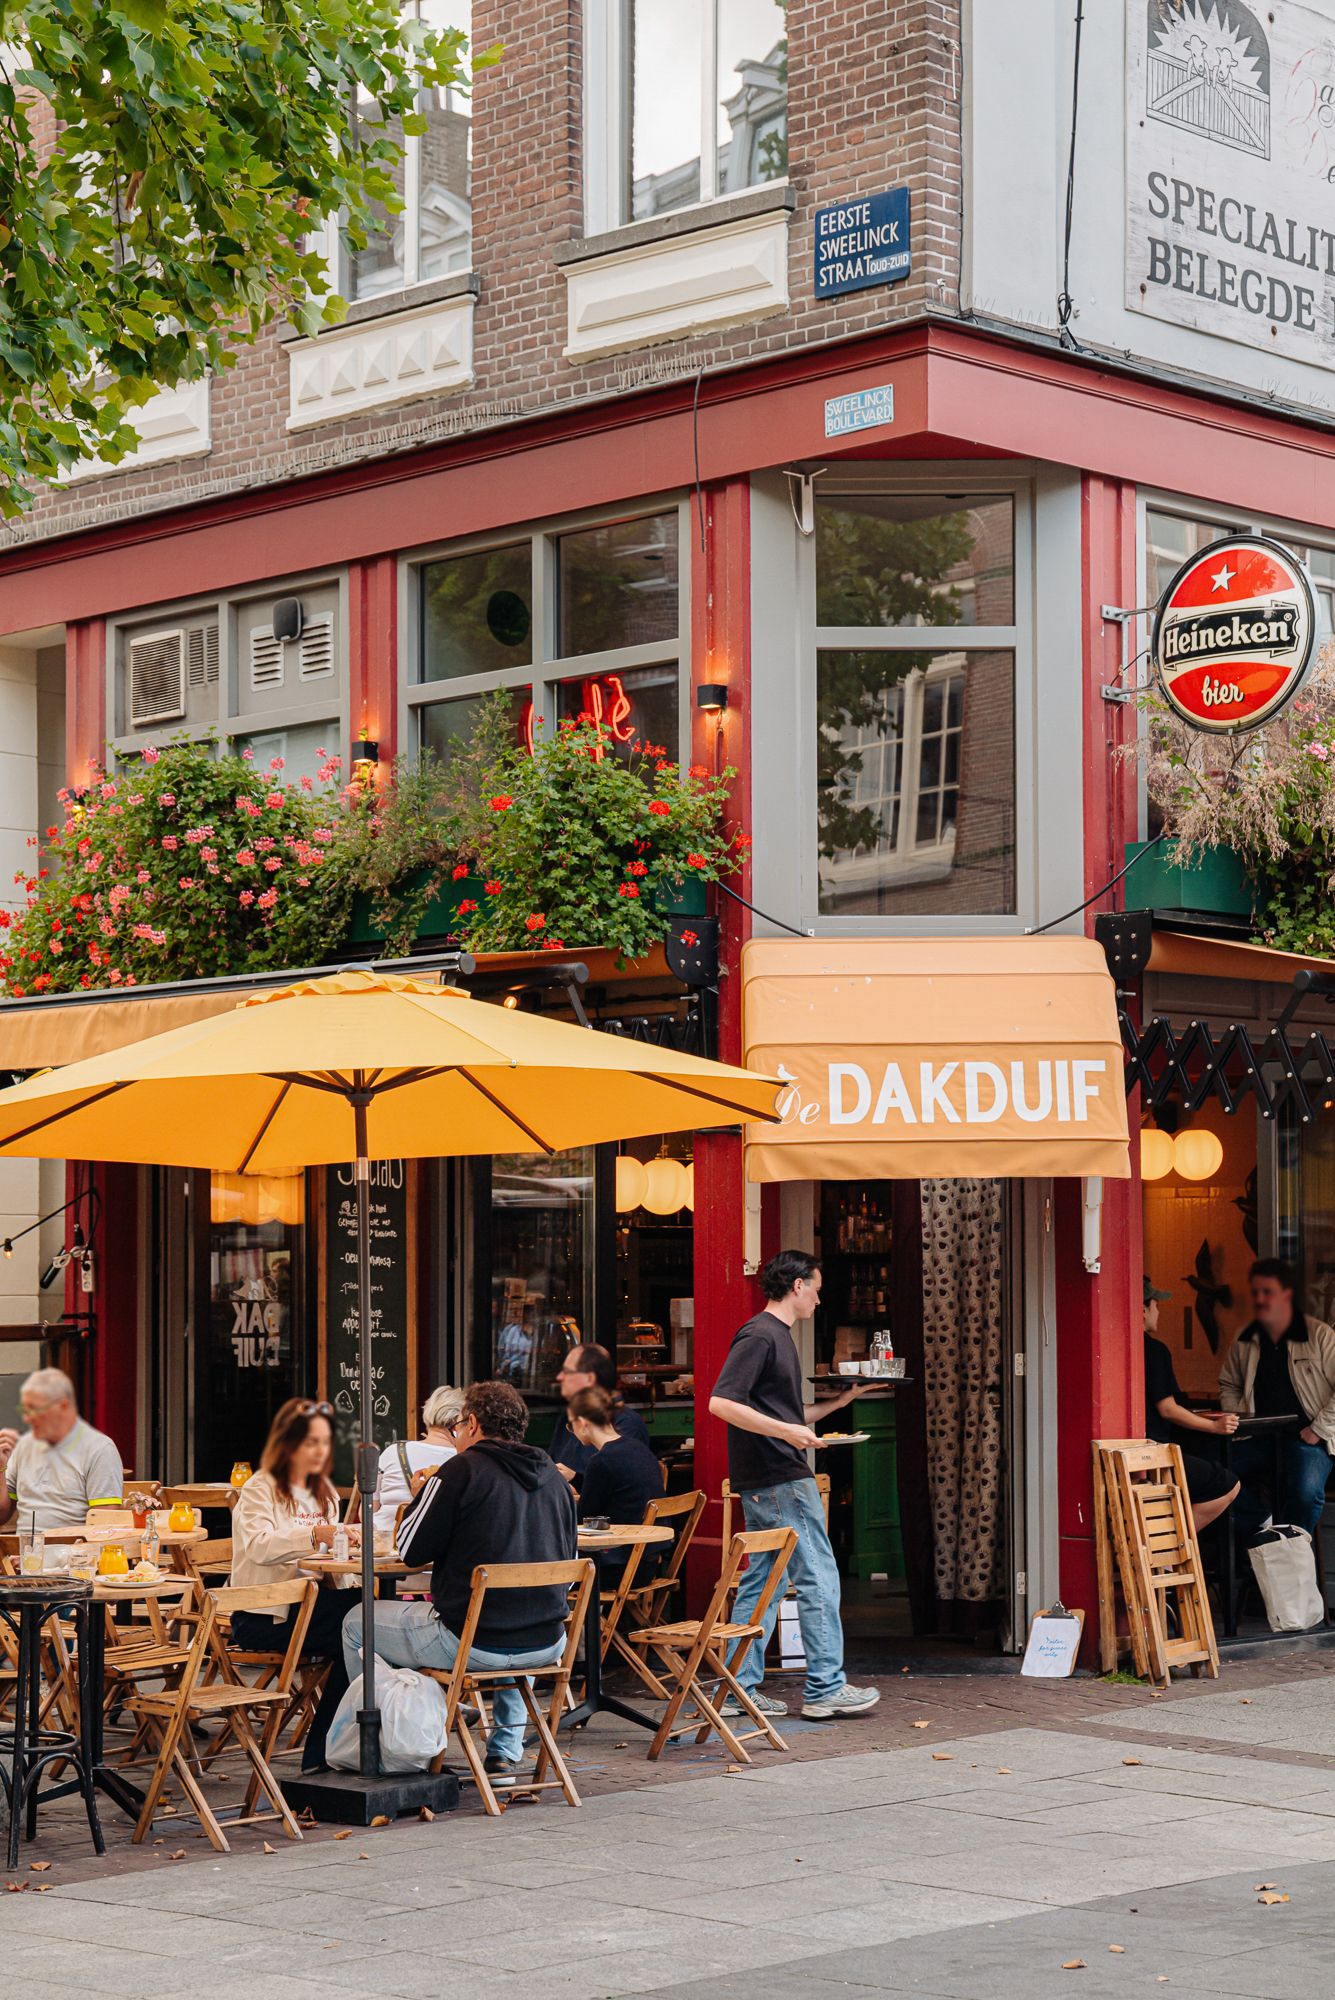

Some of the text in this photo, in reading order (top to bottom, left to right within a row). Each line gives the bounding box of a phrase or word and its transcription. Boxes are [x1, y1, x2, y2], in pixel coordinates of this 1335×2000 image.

[820, 202, 871, 236] EERSTE
[819, 220, 900, 262] SWEELINCK
[819, 254, 873, 288] STRAAT
[870, 253, 910, 274] OUD-ZUID
[1146, 236, 1316, 332] BELEGDE
[827, 389, 891, 417] SWEELINCK
[827, 404, 891, 433] BOULEVARD
[1165, 616, 1291, 659] Heineken
[1201, 675, 1245, 707] bier
[828, 1060, 1106, 1125] DAKDUIF
